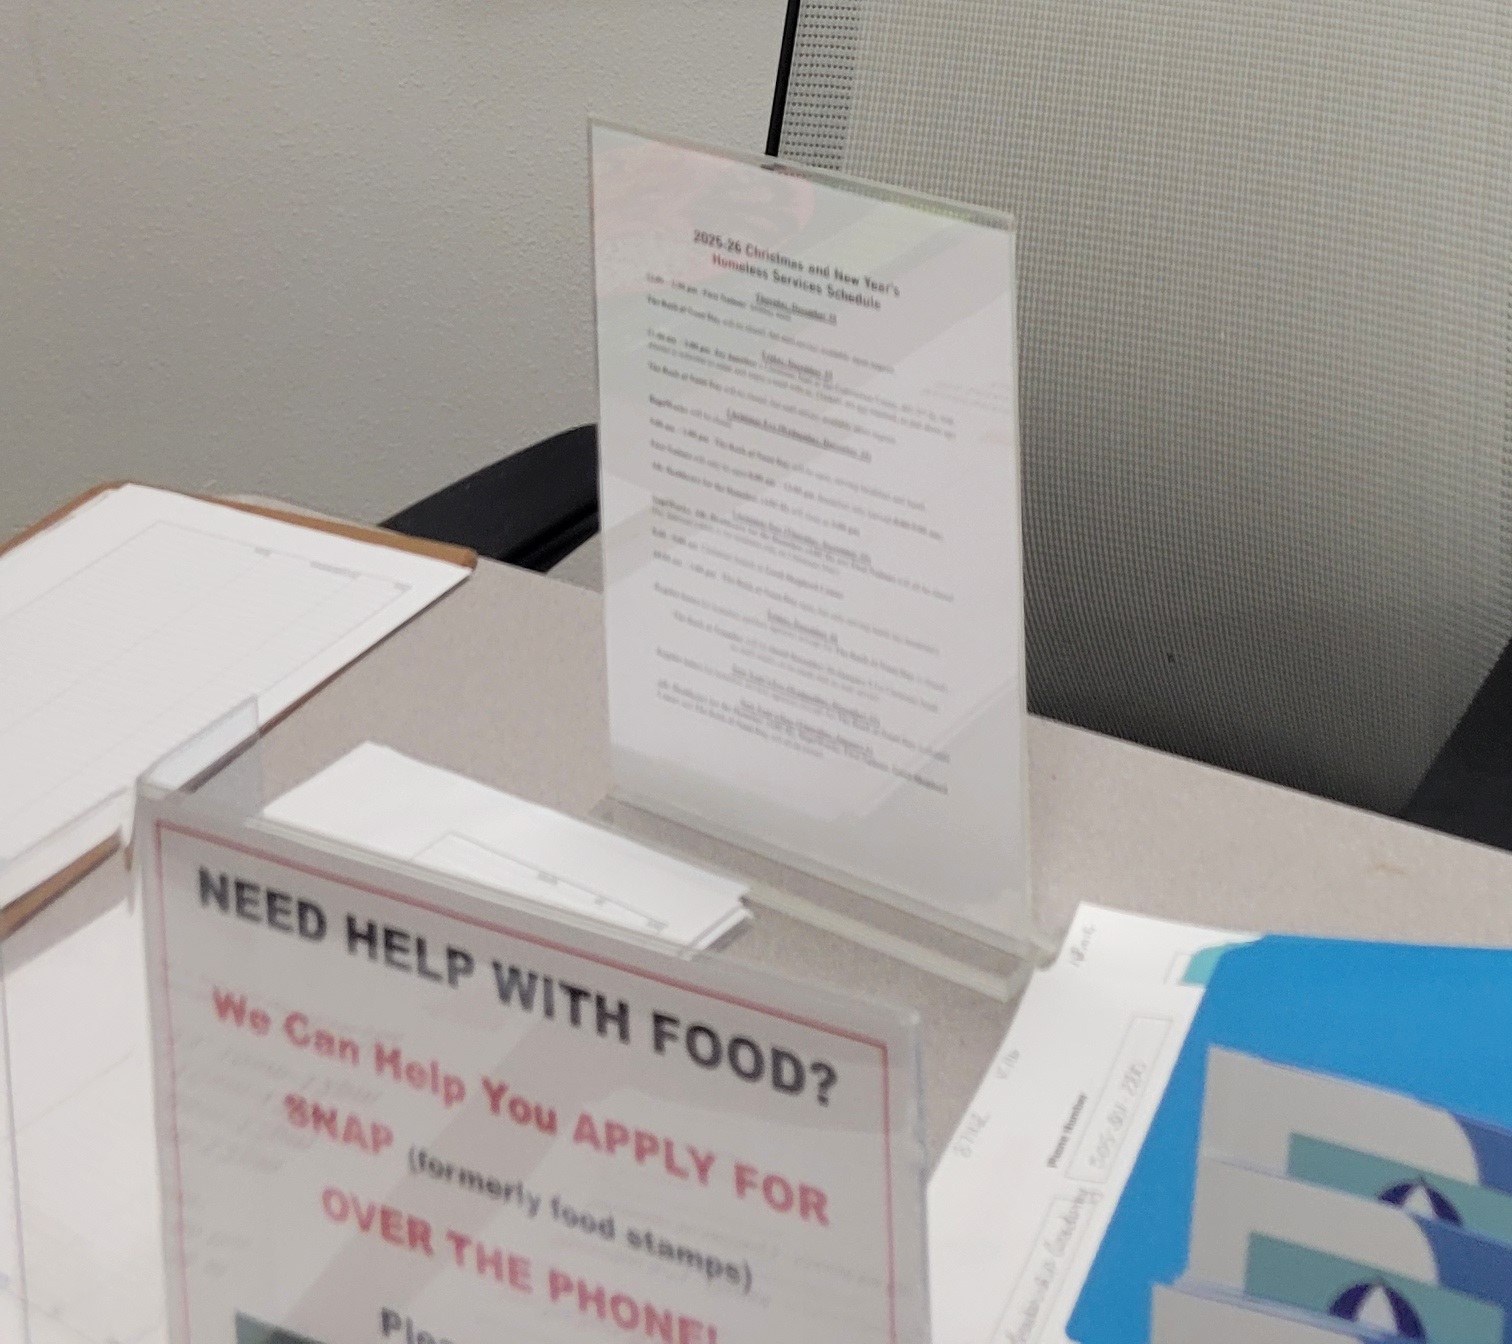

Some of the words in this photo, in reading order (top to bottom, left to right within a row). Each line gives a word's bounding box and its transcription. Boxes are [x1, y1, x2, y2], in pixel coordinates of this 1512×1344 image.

[712, 252, 769, 281] Homeless
[772, 268, 823, 295] Services
[827, 284, 882, 311] Schedule
[745, 242, 804, 272] Christmas
[807, 264, 831, 279] and
[834, 267, 860, 286] New
[864, 275, 901, 298] Year's
[198, 865, 328, 944] NEED
[345, 912, 476, 989] HELP
[491, 960, 632, 1046] WITH
[651, 1011, 839, 1109] FOOD?
[210, 984, 272, 1037] We
[282, 1010, 361, 1066] Can
[373, 1041, 467, 1110] Help
[480, 1075, 558, 1136] You
[572, 1110, 717, 1187] APPLY
[732, 1161, 831, 1227] FOR
[284, 1093, 395, 1156] SNAP
[407, 1147, 543, 1217] (formerly
[549, 1195, 616, 1241] food
[627, 1226, 754, 1297] stamps)
[321, 1185, 436, 1258] OVER
[446, 1228, 533, 1294] THE
[380, 1307, 455, 1344] Ple
